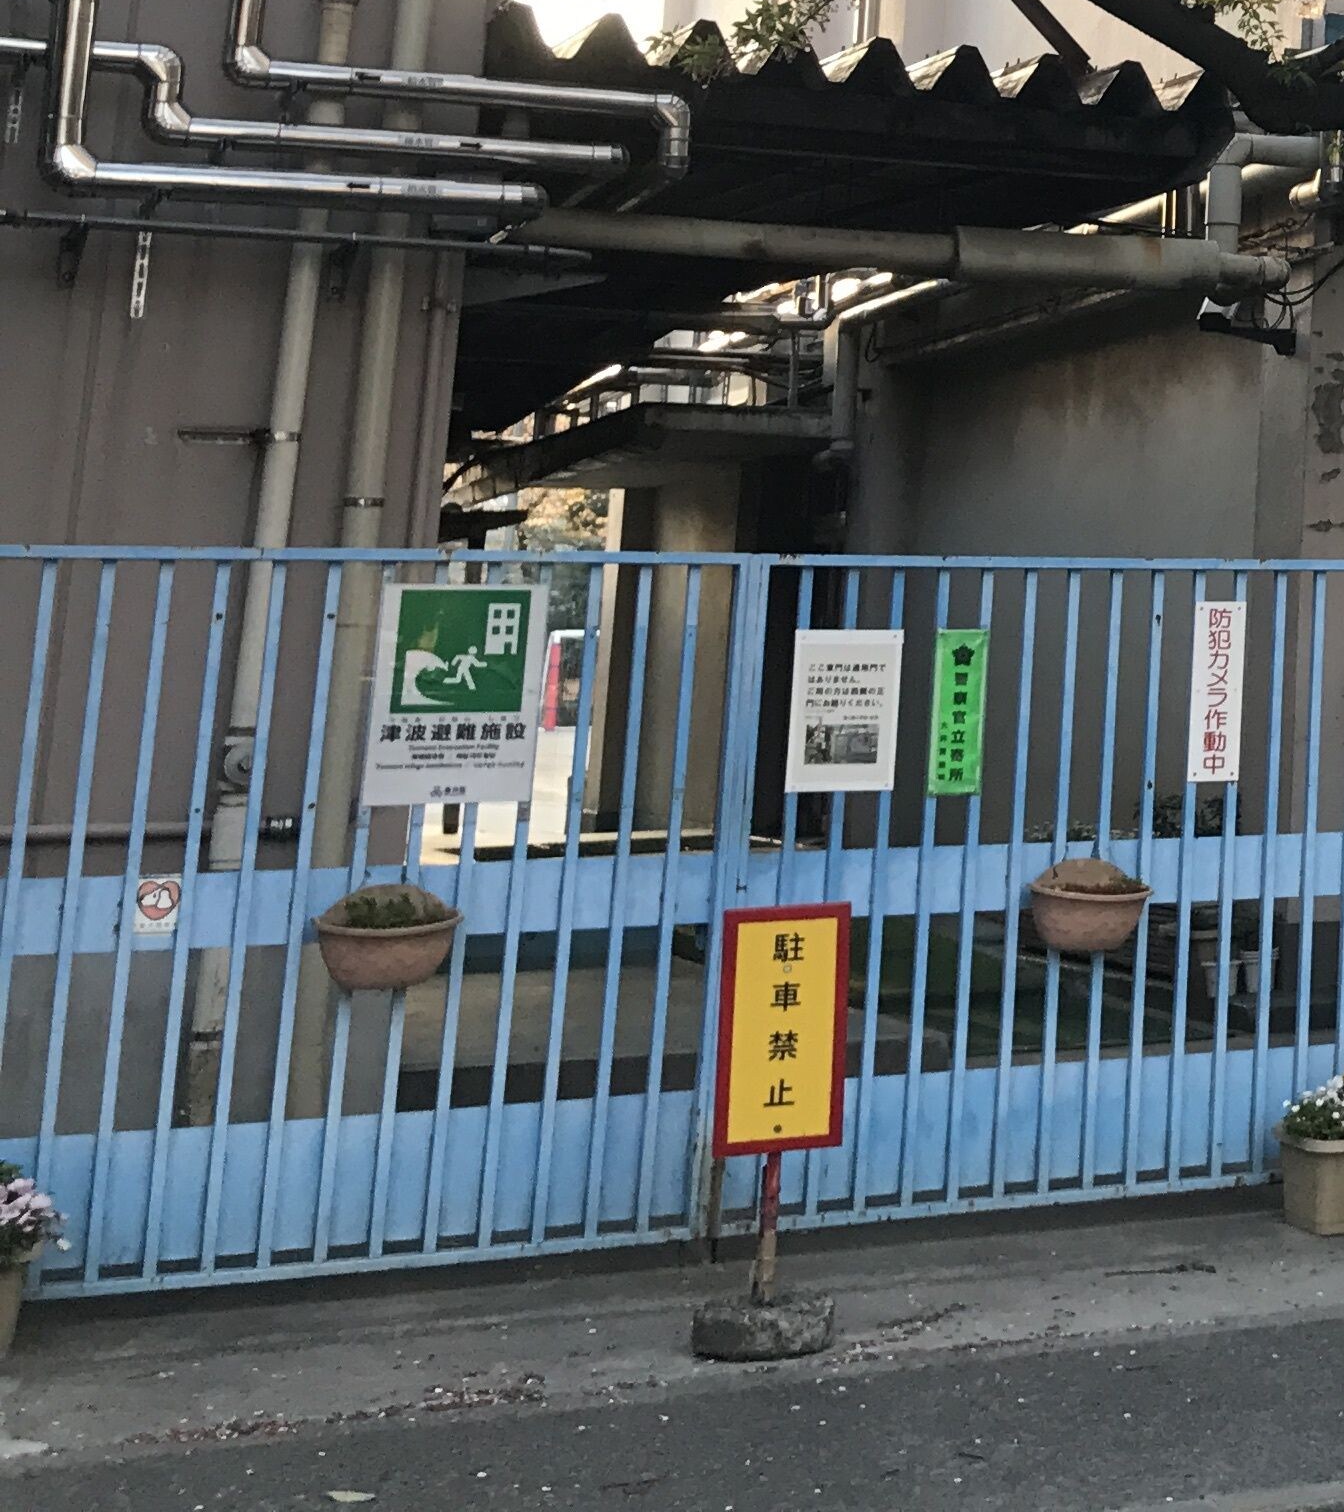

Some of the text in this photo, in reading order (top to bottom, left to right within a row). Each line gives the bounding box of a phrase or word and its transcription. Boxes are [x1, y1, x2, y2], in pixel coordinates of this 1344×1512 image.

[379, 722, 527, 742] 津波避難施設
[949, 672, 968, 781] 警察官立寄所
[1202, 608, 1233, 775] 防犯カメラ作動中
[763, 932, 805, 1108] 駐車禁止
